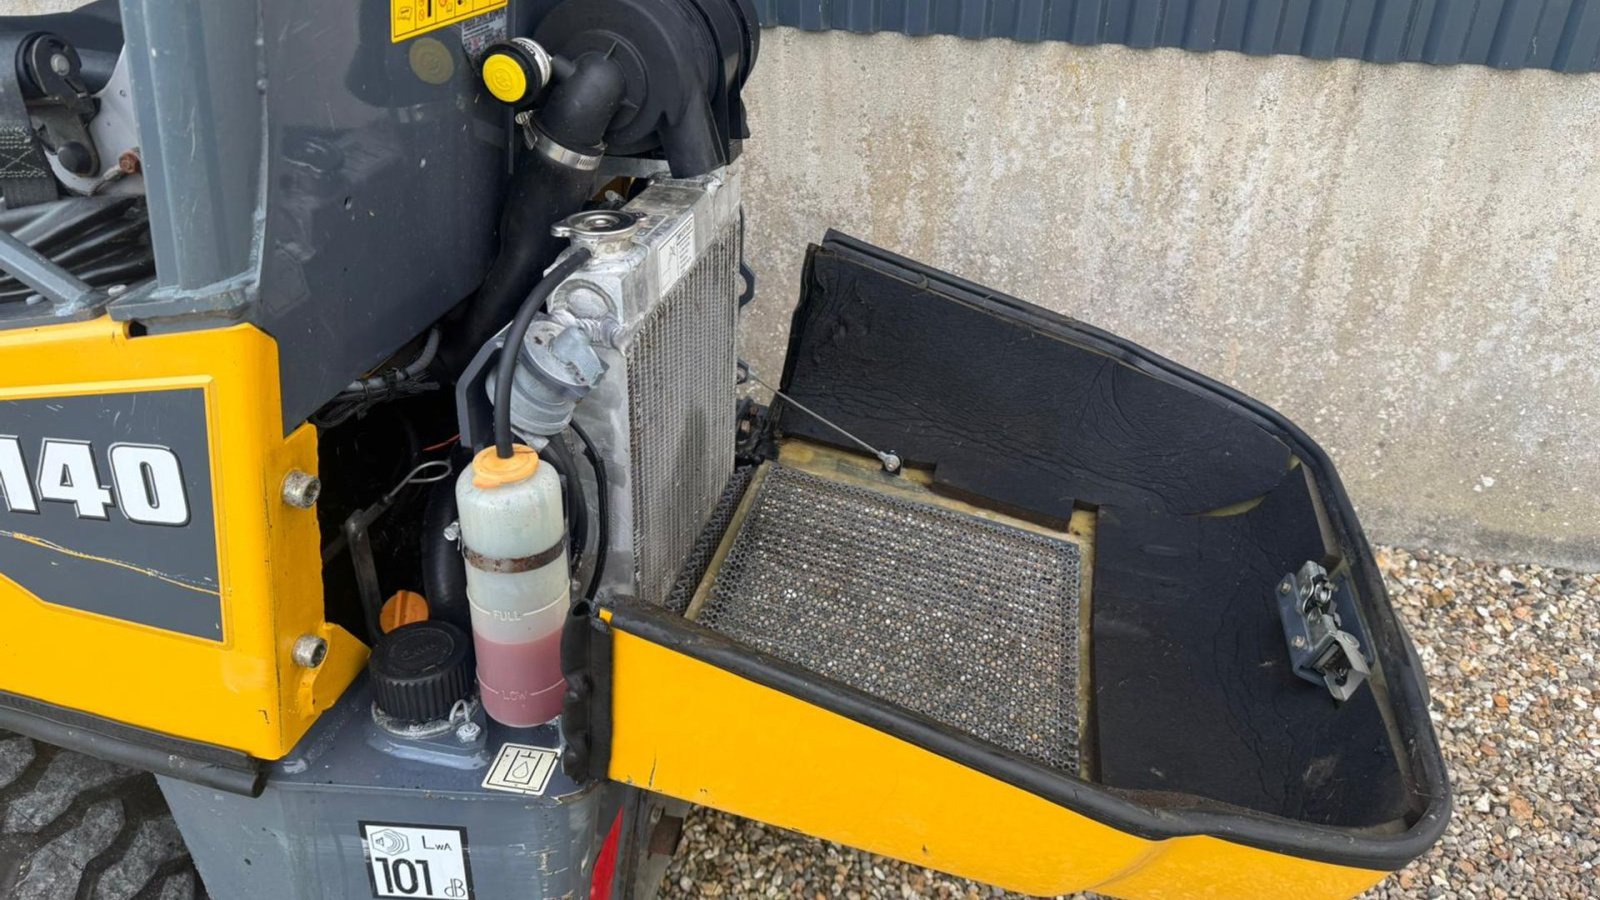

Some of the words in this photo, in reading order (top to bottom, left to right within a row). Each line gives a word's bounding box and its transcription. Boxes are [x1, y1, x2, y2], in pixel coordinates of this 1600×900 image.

[493, 608, 522, 622] FULL
[501, 689, 528, 701] LOW
[375, 857, 434, 896] 101
[444, 878, 466, 898] dB
